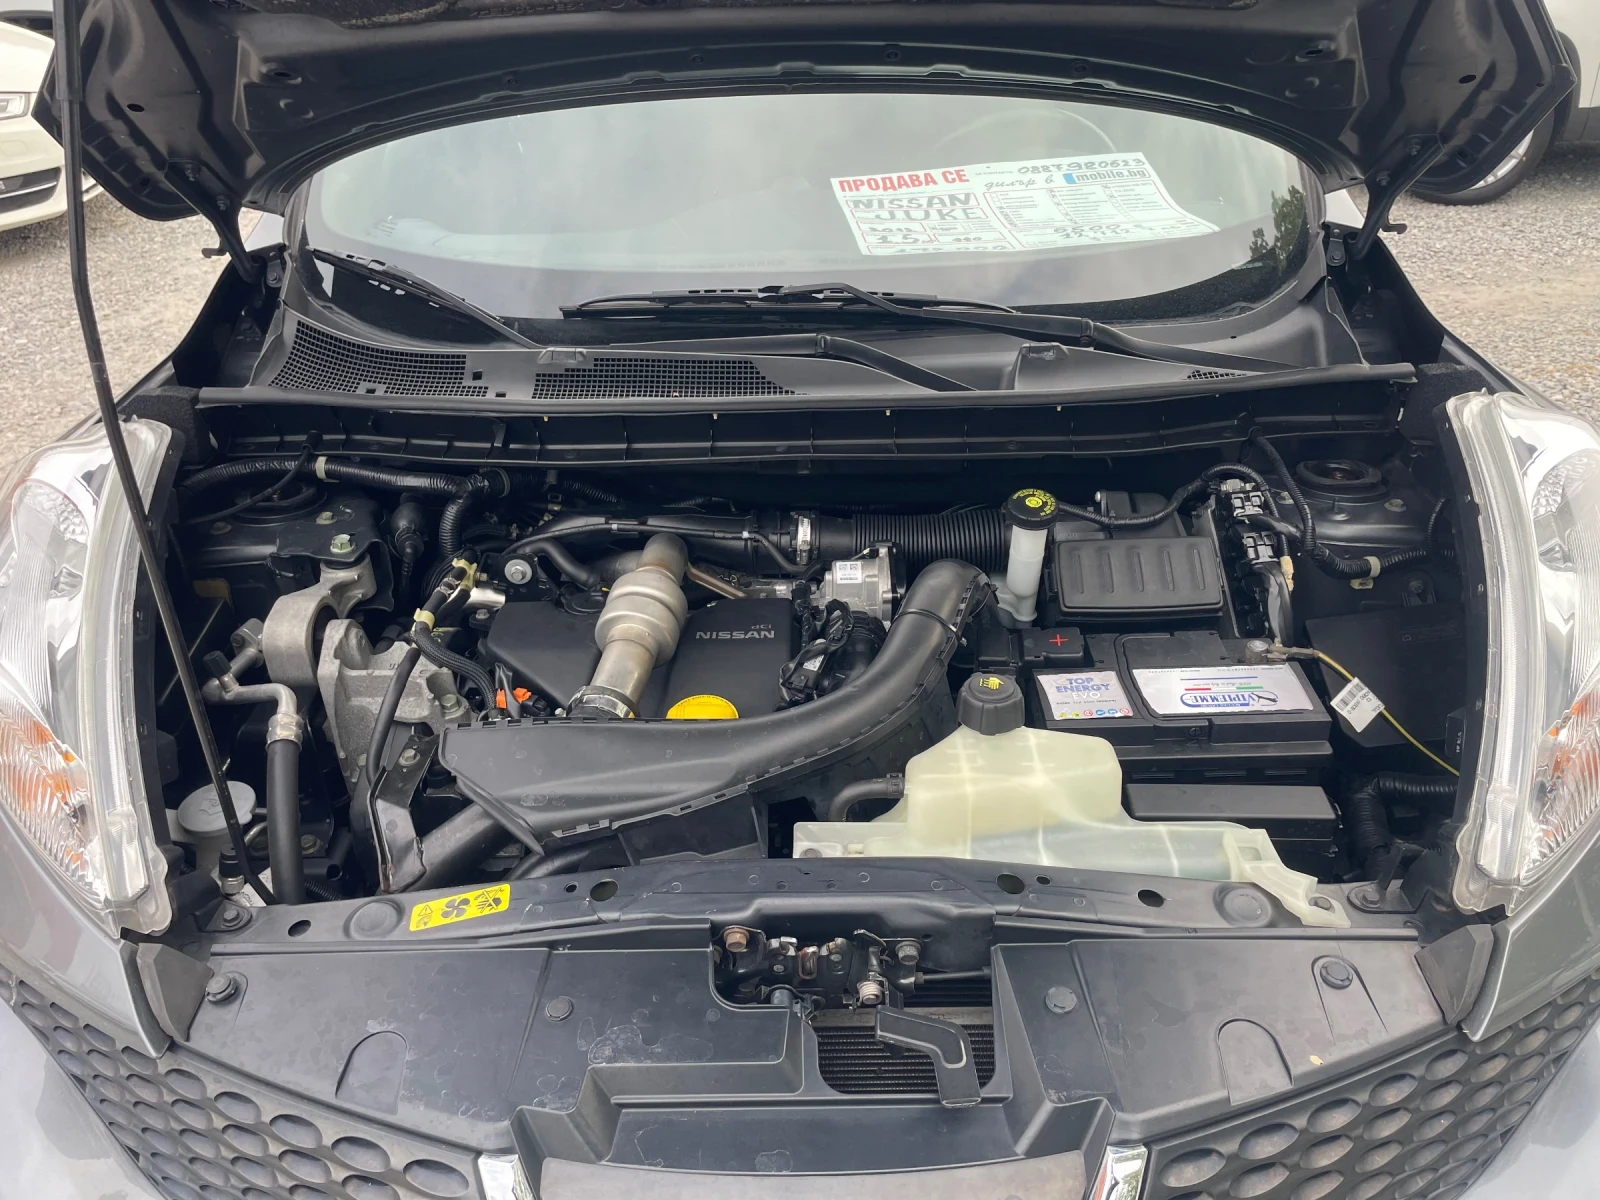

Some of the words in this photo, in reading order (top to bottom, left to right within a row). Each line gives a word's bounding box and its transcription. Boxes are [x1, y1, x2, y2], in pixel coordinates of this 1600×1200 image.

[838, 172, 938, 192] ПРОДАВА
[941, 169, 970, 183] СЕ
[1075, 168, 1148, 182] mobile.bg
[852, 192, 971, 209] NISSAN
[874, 208, 983, 221] JUKE
[695, 630, 775, 639] NISSAN
[1066, 677, 1094, 685] TOP
[1056, 683, 1110, 693] ENERGY
[1072, 691, 1101, 700] EVO
